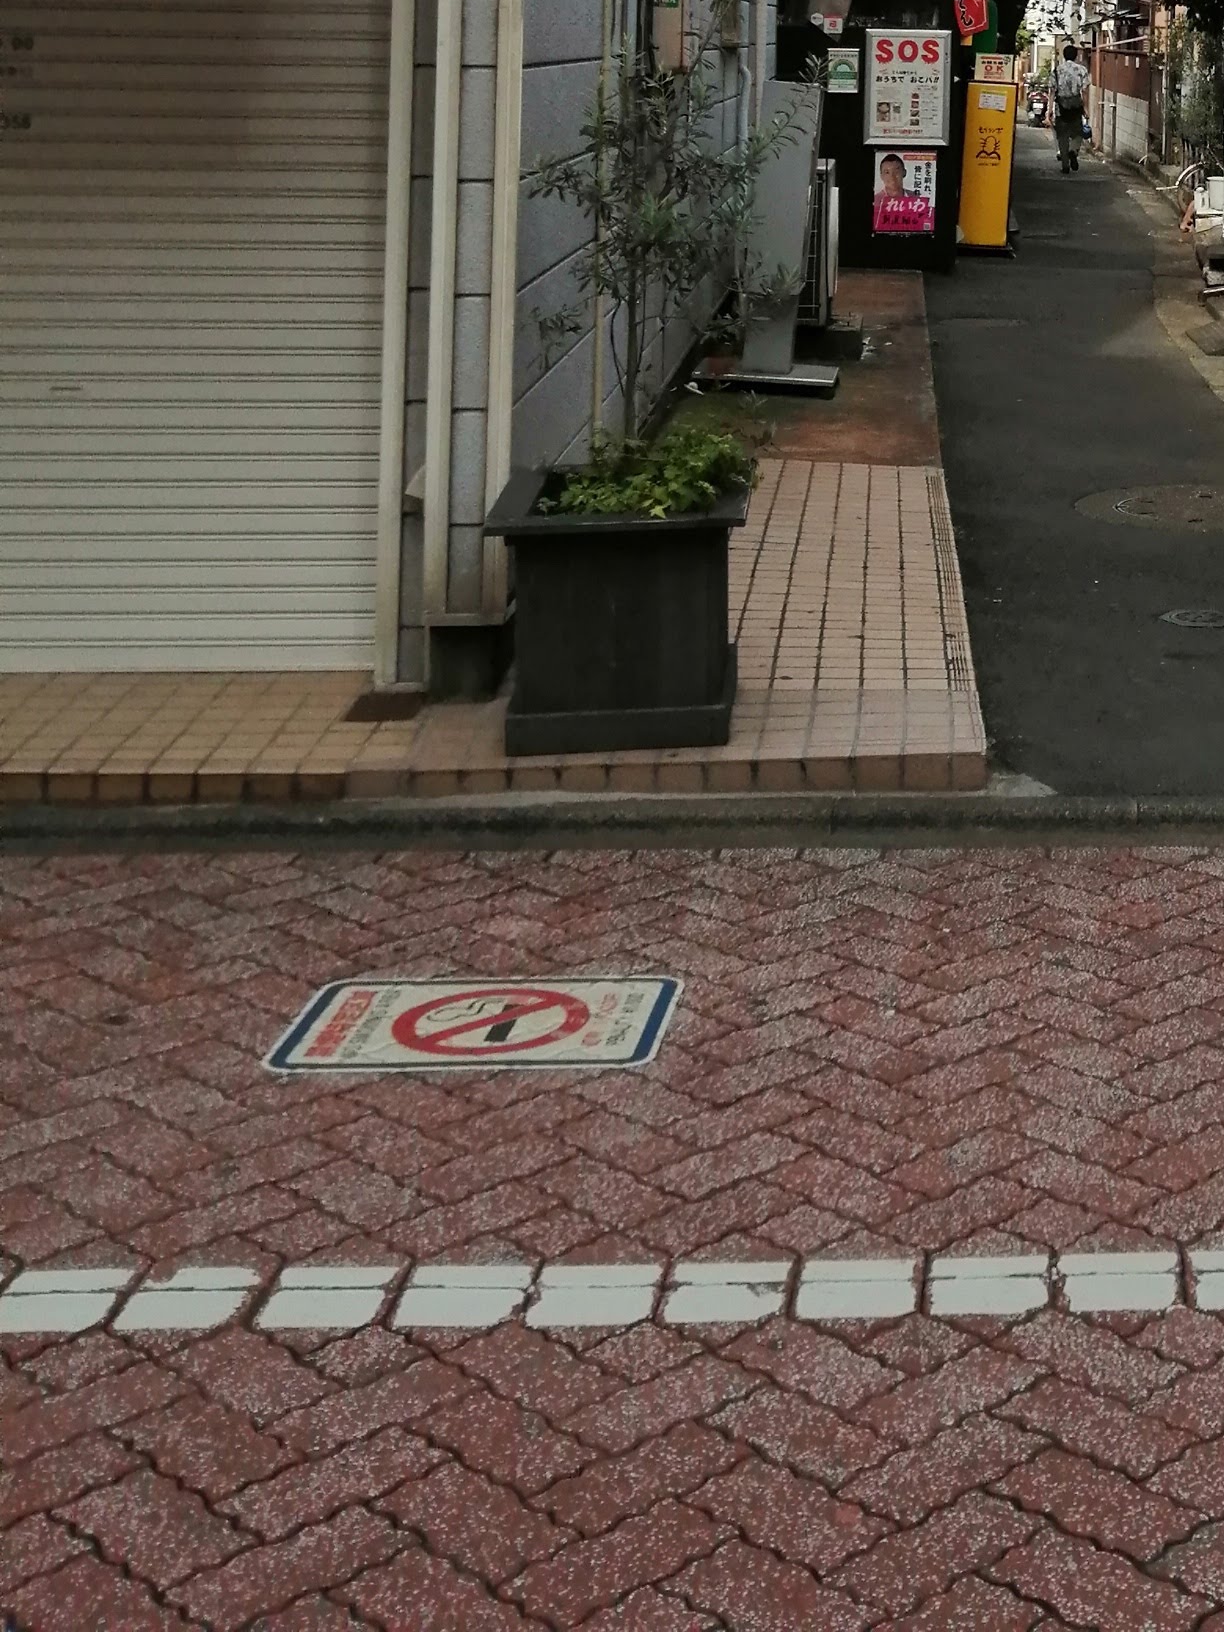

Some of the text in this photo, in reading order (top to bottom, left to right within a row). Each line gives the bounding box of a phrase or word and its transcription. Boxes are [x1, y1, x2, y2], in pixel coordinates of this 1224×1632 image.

[875, 39, 940, 64] SOS
[876, 76, 904, 84] おうちで
[885, 198, 926, 212] れいわ
